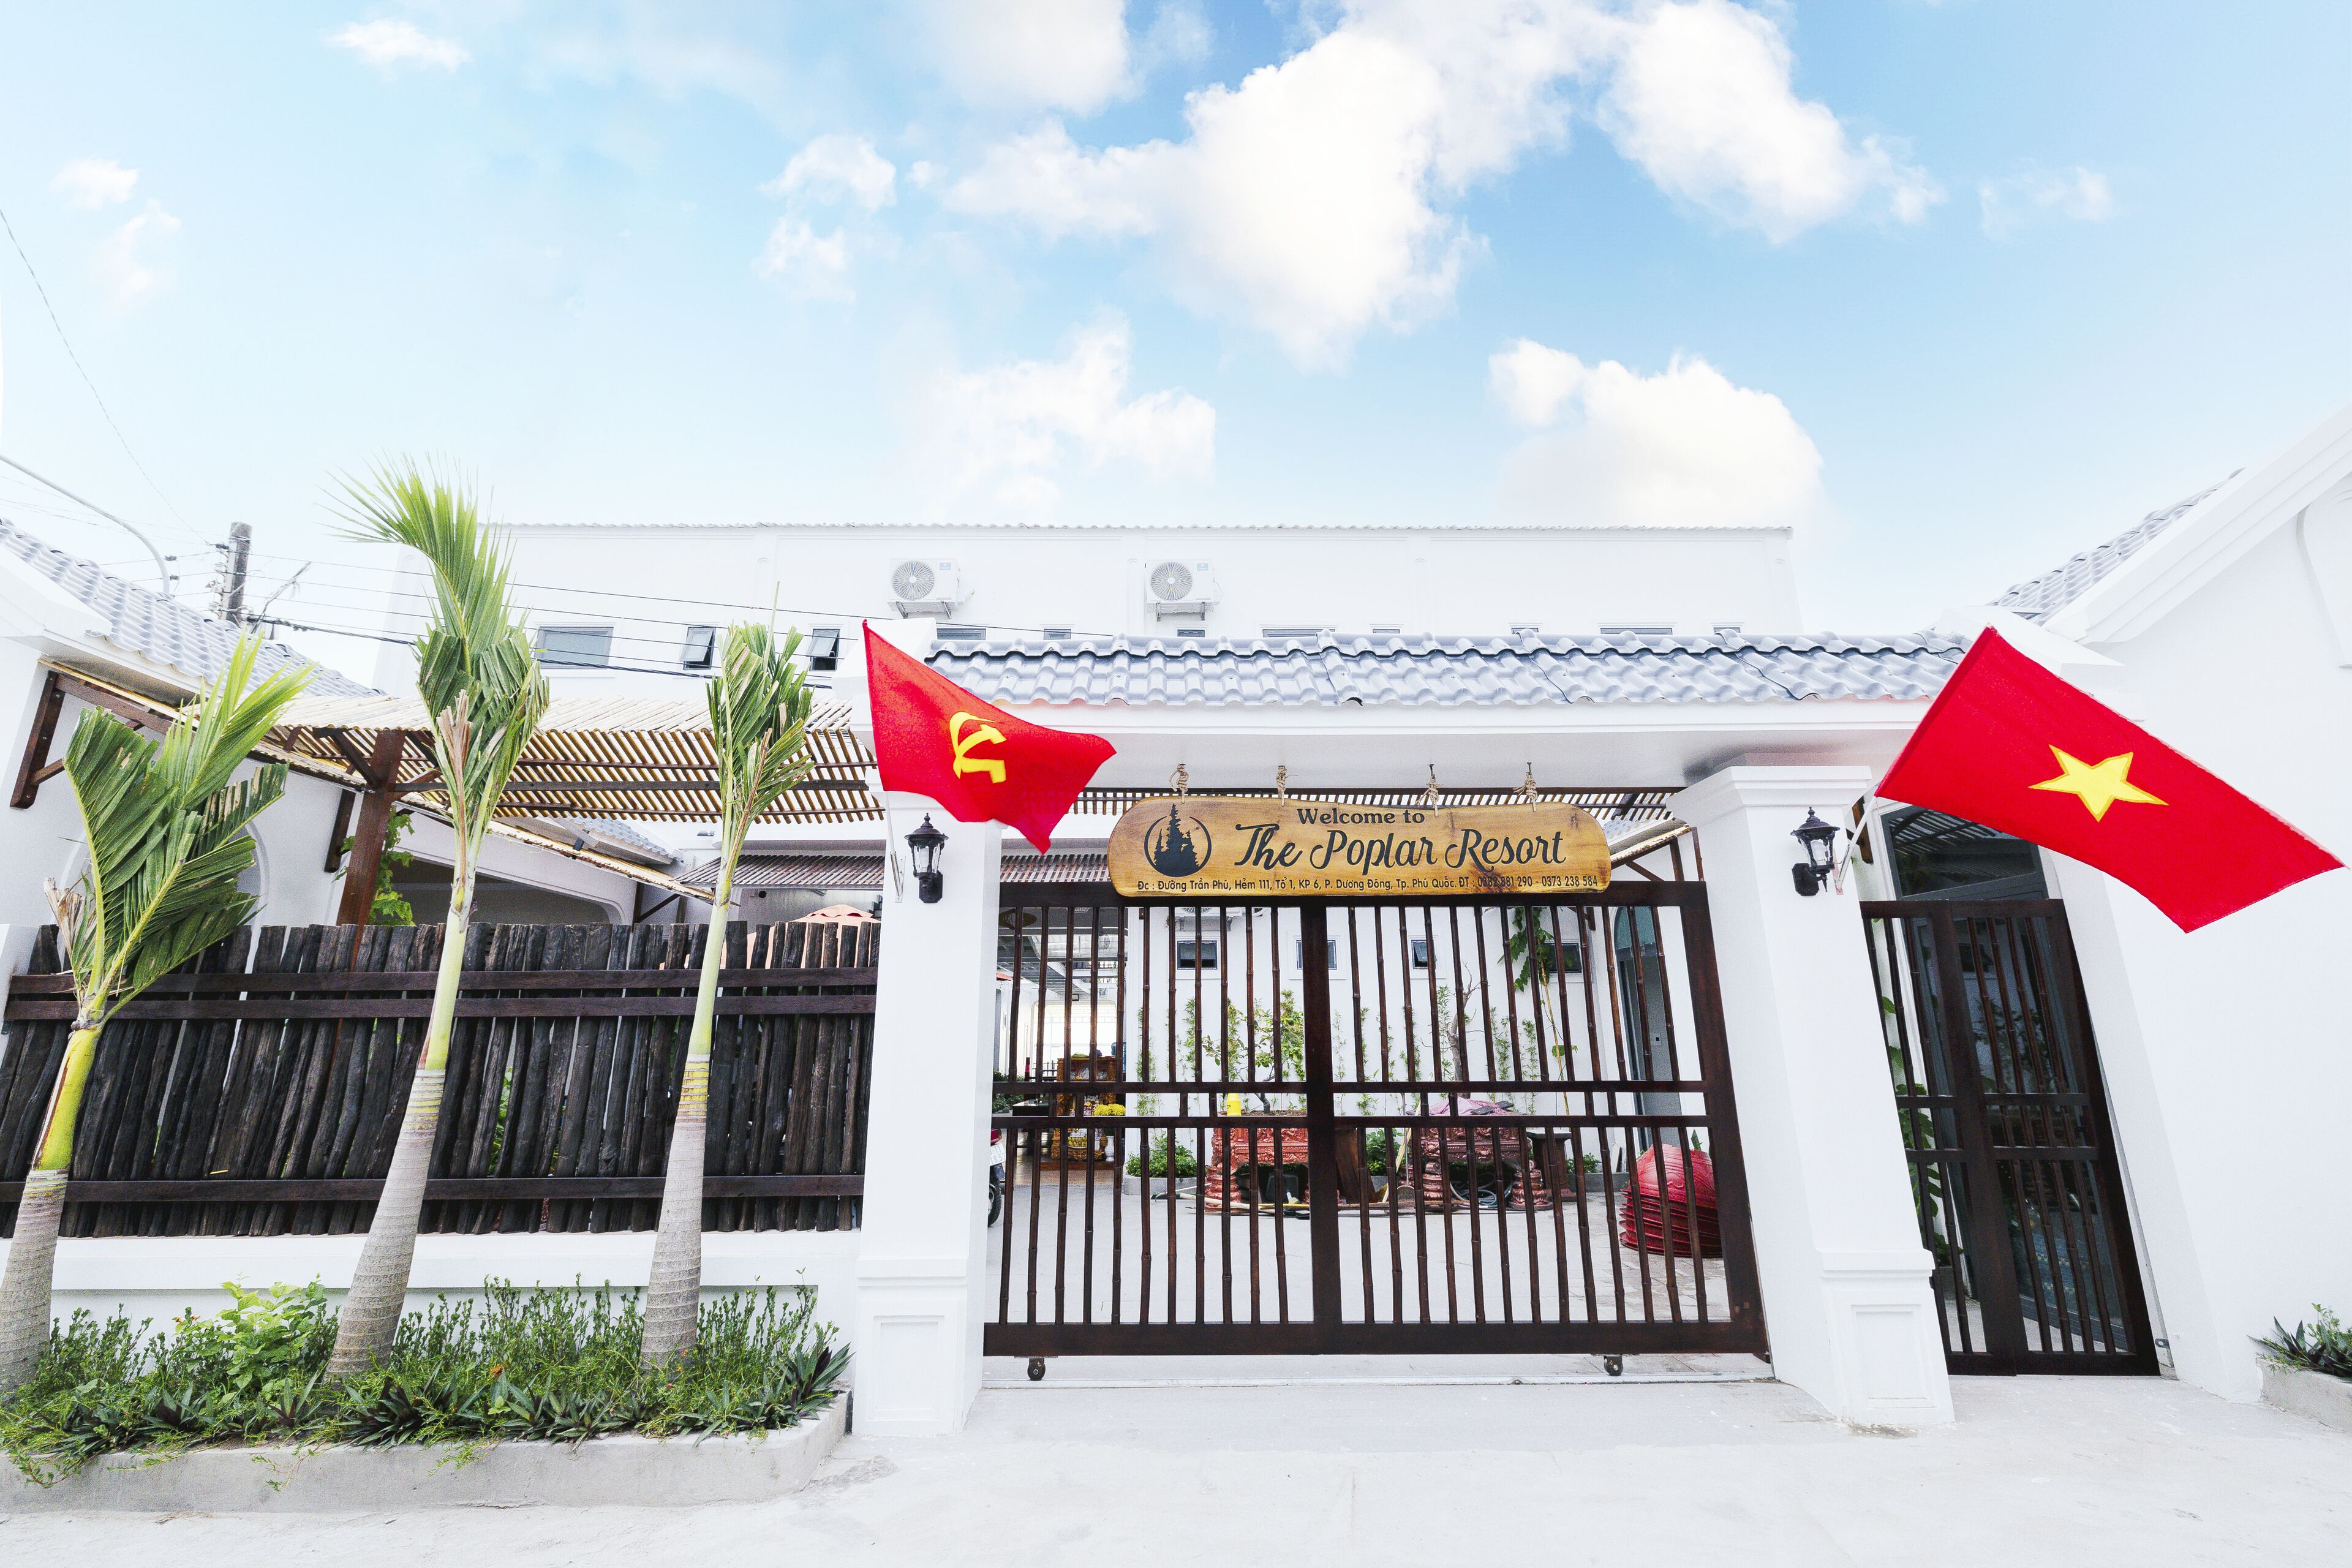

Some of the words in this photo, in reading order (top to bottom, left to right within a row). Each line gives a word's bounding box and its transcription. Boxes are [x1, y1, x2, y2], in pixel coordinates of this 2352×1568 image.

[1297, 808, 1395, 824] Welcome
[1403, 809, 1425, 824] to
[1234, 823, 1303, 870] The
[1310, 829, 1438, 876] Poplar
[1444, 828, 1567, 873] Resort
[1137, 880, 1149, 890] Đc
[1189, 877, 1209, 889] Trần
[1213, 879, 1231, 891] Phú,
[1235, 878, 1256, 889] Hẻm
[1259, 880, 1272, 891] 111,
[1275, 876, 1287, 889] Tổ
[1289, 880, 1295, 890] 1,
[1299, 879, 1310, 889] KP
[1313, 879, 1322, 890] 6,
[1325, 879, 1333, 888] P.
[1336, 879, 1364, 891] Dương
[1367, 878, 1393, 890] Đông,
[1396, 879, 1409, 890] Tp.
[1412, 878, 1428, 888] Phú
[1432, 875, 1457, 888] Quốc.
[1459, 876, 1469, 888] ĐT
[1501, 876, 1515, 887] 881
[1517, 876, 1532, 887] 290
[1542, 875, 1562, 887] 0373
[1564, 875, 1580, 887] 238
[1583, 875, 1598, 886] 584
